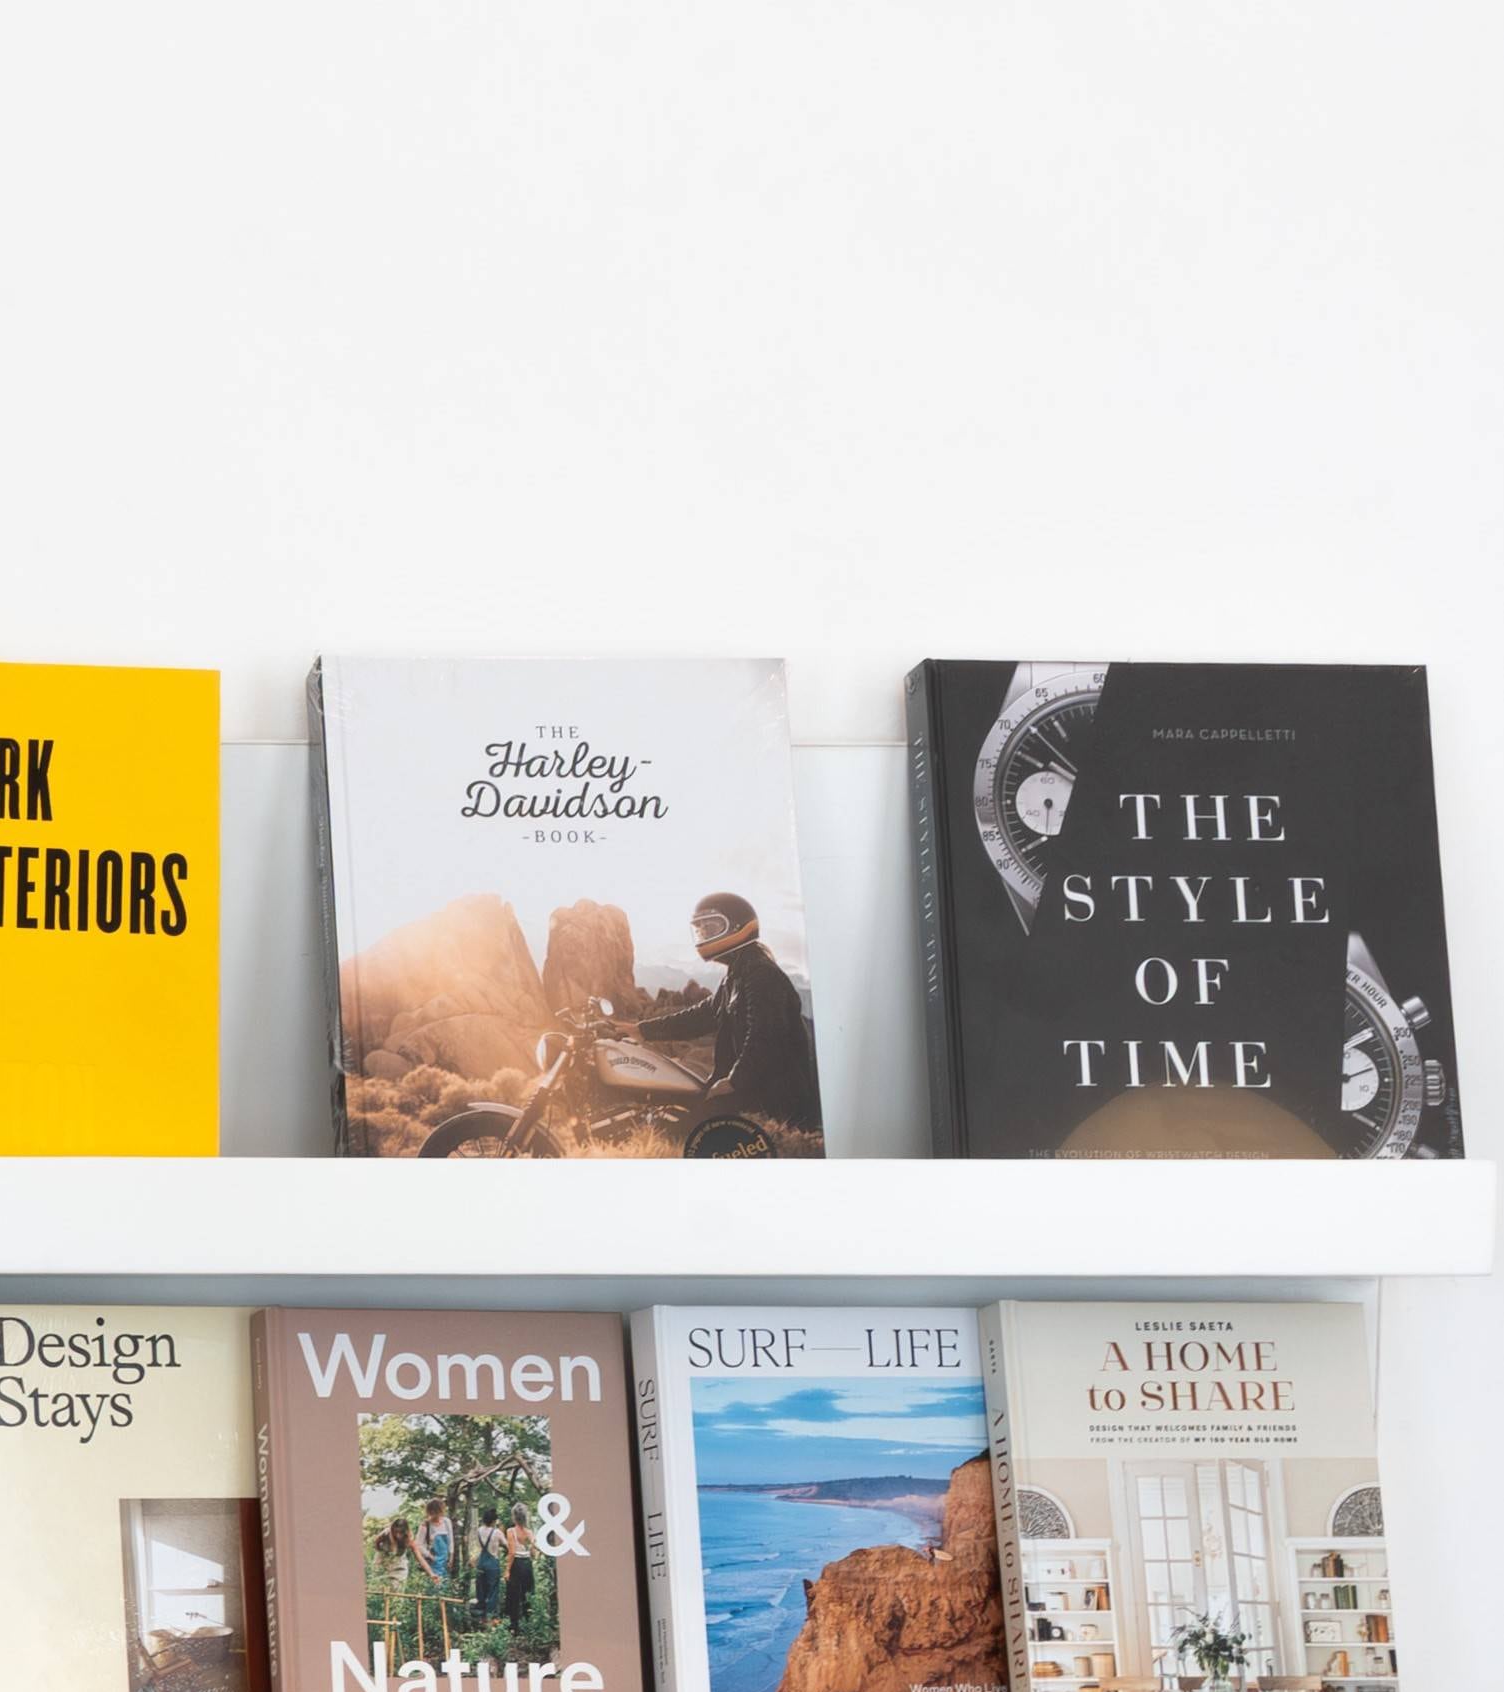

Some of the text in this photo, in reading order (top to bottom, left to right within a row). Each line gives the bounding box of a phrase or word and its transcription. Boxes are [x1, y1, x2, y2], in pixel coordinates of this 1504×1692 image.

[1035, 687, 1049, 698] 65
[535, 725, 581, 739] THE
[998, 719, 1011, 731] 70
[1152, 727, 1297, 742] MARA CAPPELLETTI
[484, 740, 653, 794] Harley-
[460, 779, 669, 820] Davidson
[1118, 793, 1286, 841] THE
[1062, 875, 1331, 925] STYLE
[1134, 957, 1230, 1007] OF
[1360, 981, 1388, 1009] HOUR
[1062, 1039, 1272, 1089] TIME
[1134, 1321, 1234, 1332] LESLIE SAETA
[296, 1330, 603, 1403] Women
[1098, 1340, 1278, 1372] A HOME
[1086, 1380, 1296, 1412] to SHARE
[534, 1491, 591, 1558] &
